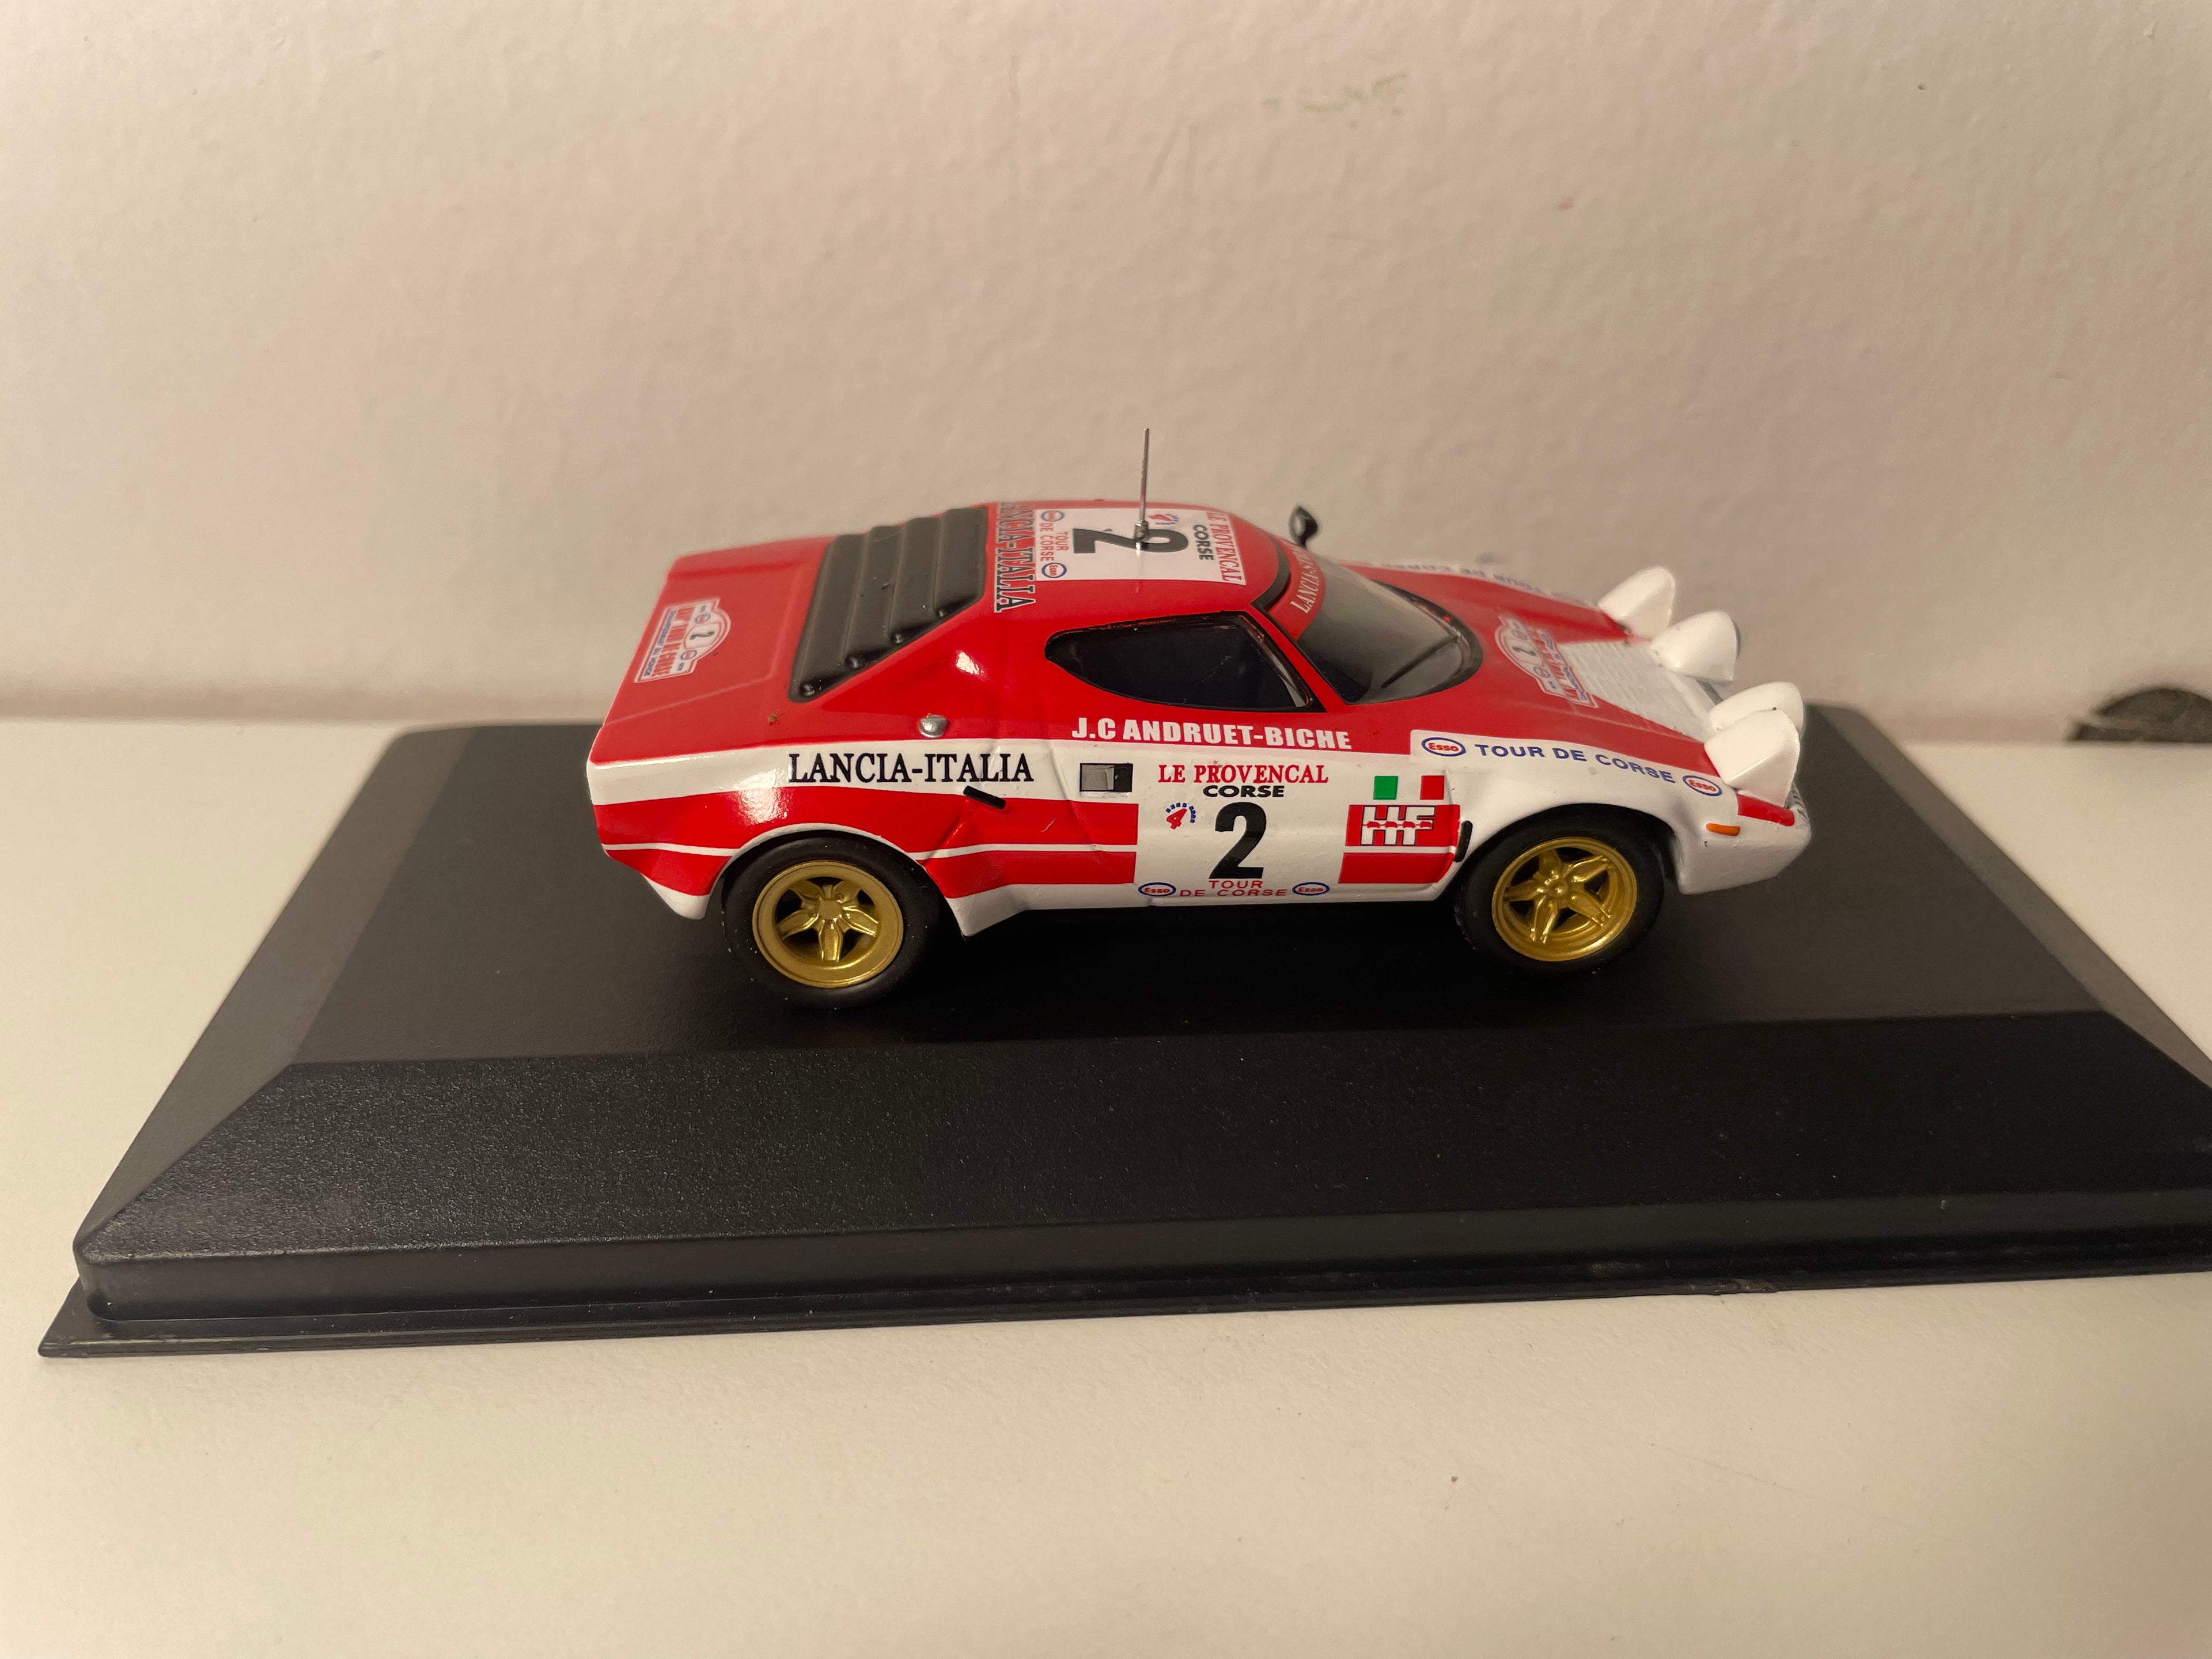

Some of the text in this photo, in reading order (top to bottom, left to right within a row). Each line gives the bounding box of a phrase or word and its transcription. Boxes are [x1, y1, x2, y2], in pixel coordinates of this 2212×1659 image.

[1040, 522, 1055, 562] DE CORSE
[1055, 531, 1070, 551] TOUR
[1192, 524, 1215, 561] CORSE
[1072, 717, 1352, 749] J.C ANDRUET-BICHE
[789, 752, 1034, 783] LANCIA-ITALIA
[1158, 764, 1329, 784] LE PROVENCAL
[1474, 743, 1676, 784] TOUR DE CORSE
[1202, 785, 1285, 798] CORSE
[1209, 801, 1267, 879] 2
[1361, 805, 1437, 846] HF
[1209, 880, 1263, 889] TOUR
[1217, 889, 1288, 897] CORSE
